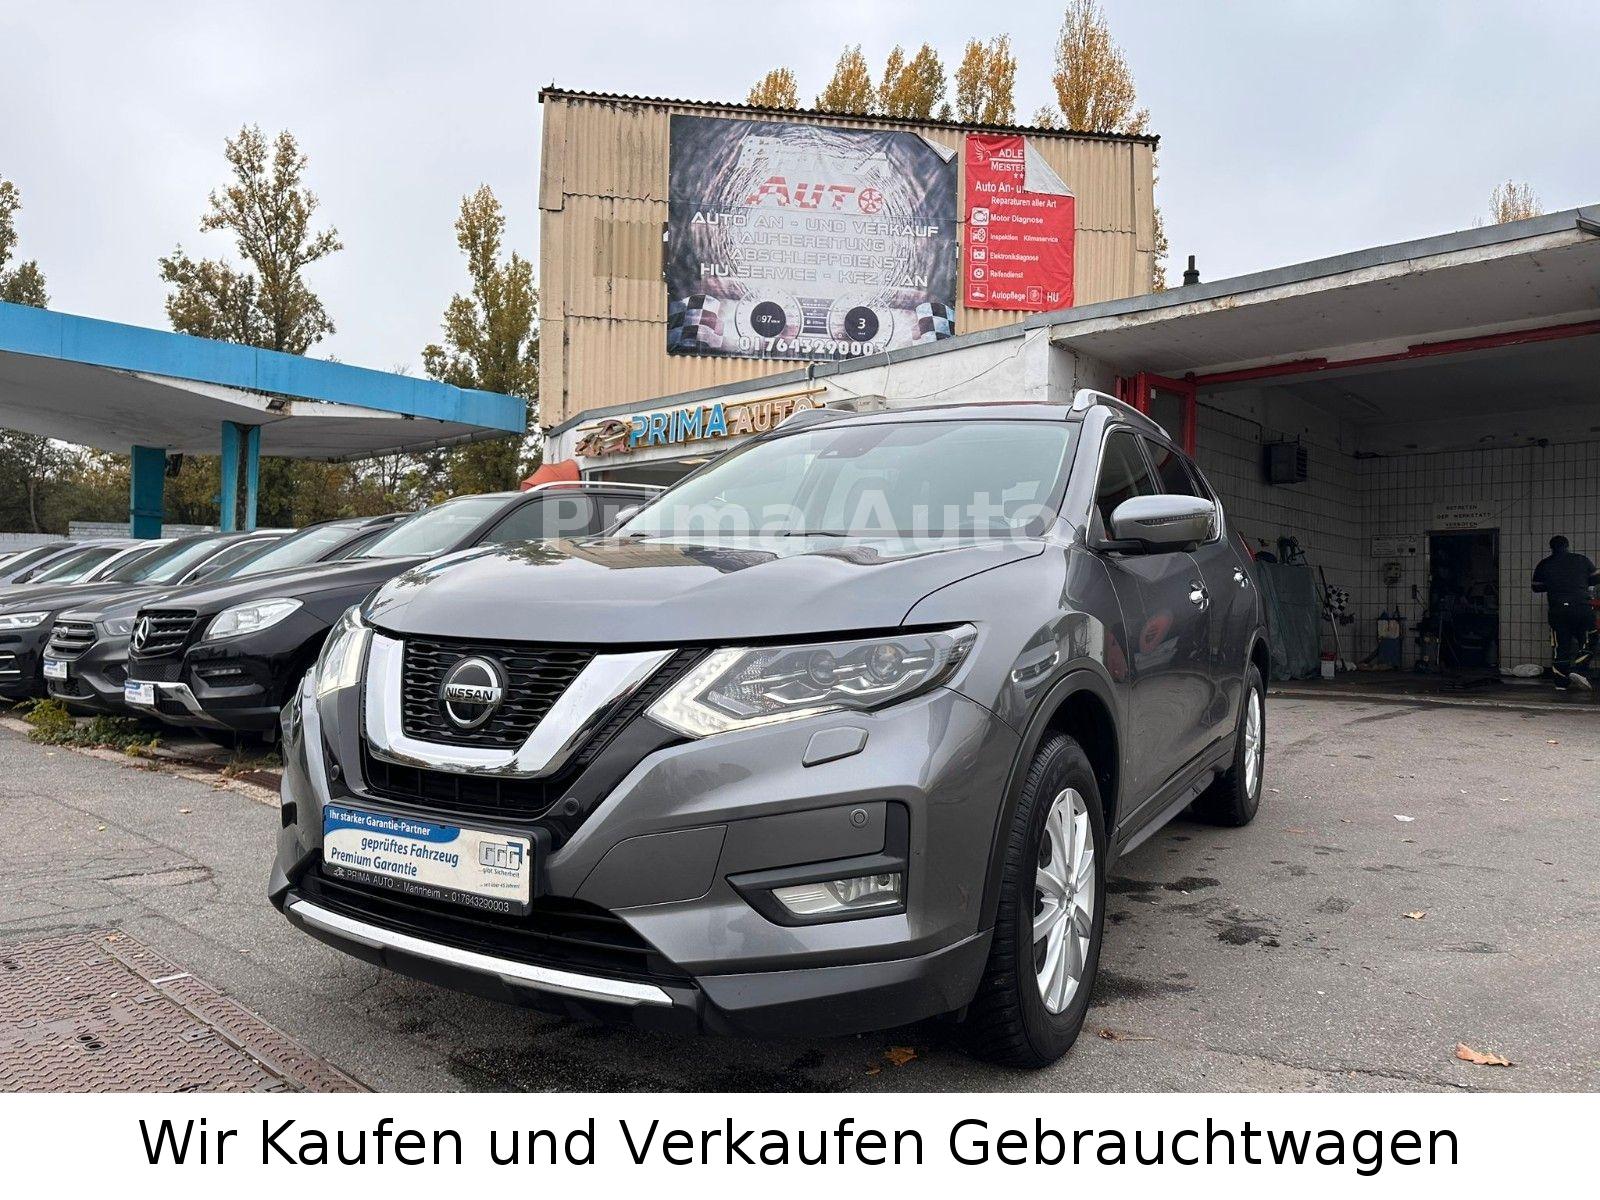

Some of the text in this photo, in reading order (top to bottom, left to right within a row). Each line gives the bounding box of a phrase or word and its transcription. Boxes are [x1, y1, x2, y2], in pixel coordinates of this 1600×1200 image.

[999, 149, 1024, 159] ADLE
[975, 182, 996, 193] Auto
[991, 196, 1057, 208] Reparaturen aller Art
[691, 211, 747, 229] AUTO
[755, 214, 783, 229] AN
[806, 219, 847, 233] UND
[853, 220, 939, 238] VERKAUF
[990, 213, 1044, 225] Motor Diagnose
[739, 231, 886, 252] AUFBEREITUNG
[730, 248, 908, 269] ABSCHLEPPDIENST
[700, 263, 728, 278] HU
[738, 264, 816, 282] SERVICE
[839, 271, 878, 286] KFZ
[991, 290, 1059, 302] Autopflege HU
[857, 318, 866, 329] 3
[739, 336, 885, 356] 017643290003
[629, 397, 816, 448] PRIMA AUTO
[446, 687, 494, 701] NISSAN
[329, 810, 430, 836] Ihr starker Garantie-Partner
[361, 836, 459, 867] geprüftes Fahrzeug
[331, 848, 418, 877] Premium Garantie
[347, 870, 370, 883] PRIMA
[373, 876, 394, 888] AUTO
[403, 881, 441, 899] Mannheim
[451, 891, 509, 913] 017643290003
